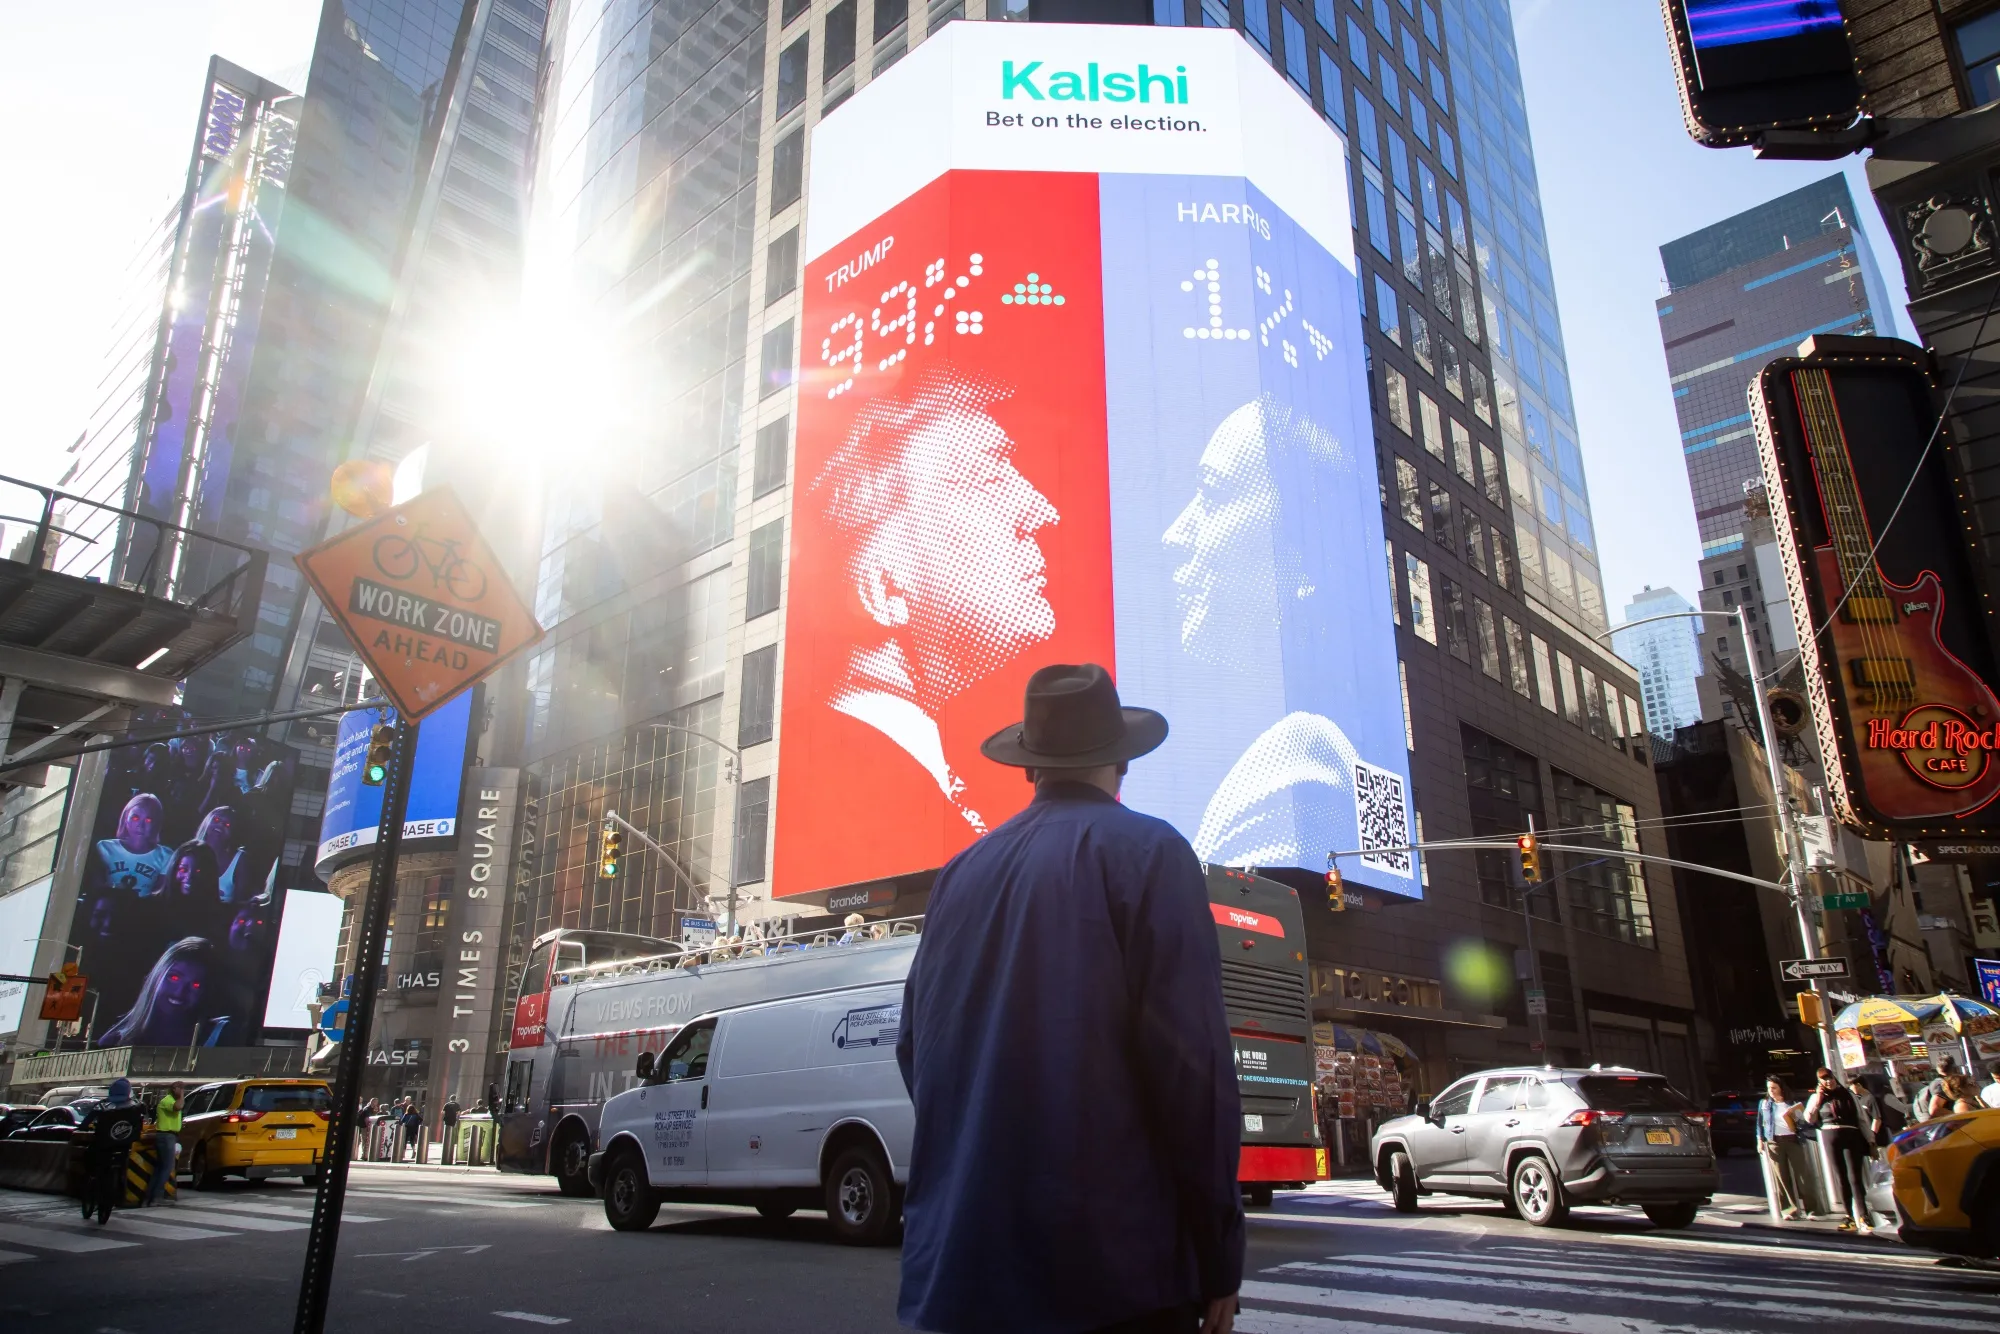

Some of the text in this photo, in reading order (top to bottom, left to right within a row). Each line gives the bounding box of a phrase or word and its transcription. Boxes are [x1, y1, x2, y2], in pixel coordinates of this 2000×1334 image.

[1002, 60, 1189, 104] Kalshi
[986, 111, 1207, 132] Bet on the election.
[1177, 202, 1271, 240] HARRIS
[825, 235, 894, 293] TRUMP
[359, 583, 497, 649] WORK ZONE
[373, 629, 469, 671] AHEAD
[1868, 719, 2000, 756] Hard Roc
[1927, 758, 1968, 772] CAFE
[403, 823, 435, 836] HASE
[328, 835, 350, 852] CHASE
[830, 891, 869, 909] branded
[1834, 896, 1840, 908] 7
[449, 789, 500, 1052] 3 TIMES SQUARE
[743, 913, 800, 946] AT&T
[397, 972, 440, 988] CHAS
[1792, 964, 1839, 974] ONE WAY
[599, 994, 693, 1023] VIEWS FROM
[594, 1029, 630, 1059] THE
[1730, 1026, 1785, 1044] Harry Potter
[367, 1050, 420, 1065] HASE
[1242, 1050, 1267, 1060] ONE WORLD
[588, 1071, 614, 1103] IN
